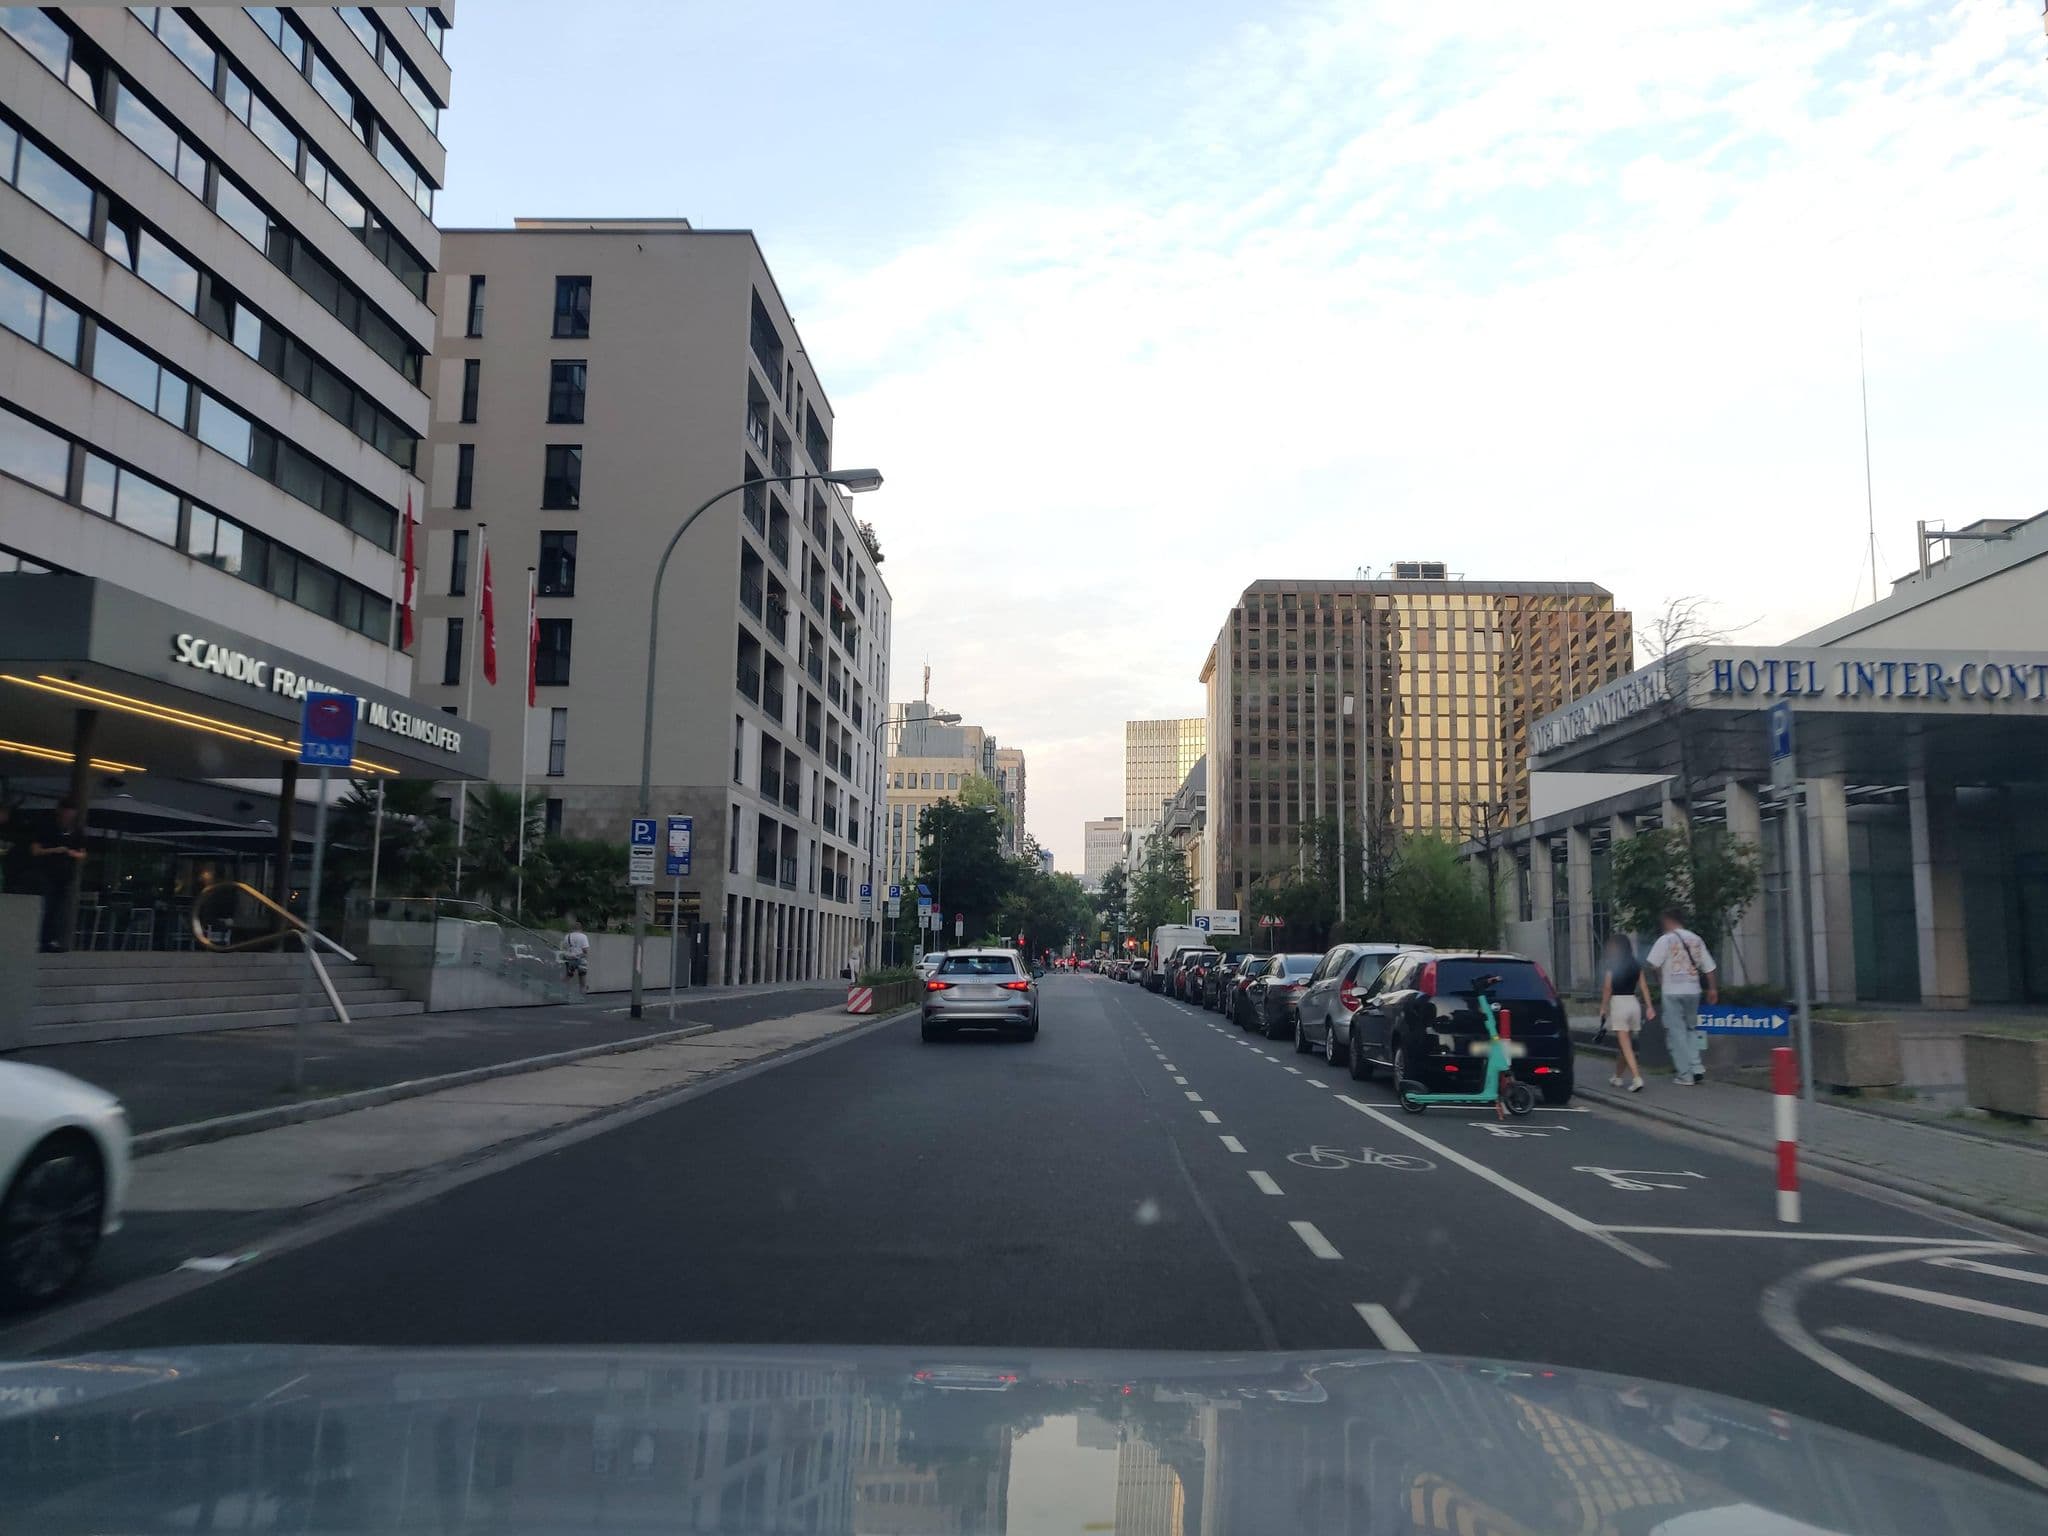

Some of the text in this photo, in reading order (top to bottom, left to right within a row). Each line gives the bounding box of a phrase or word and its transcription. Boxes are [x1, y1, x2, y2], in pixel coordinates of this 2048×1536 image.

[1711, 659, 1824, 697] HOTEL
[176, 633, 268, 688] SCANDIC
[369, 702, 460, 753] MUSEUMSUFER
[304, 742, 350, 761] TAXI
[634, 822, 650, 842] P
[1696, 1013, 1770, 1029] Einfahrt
